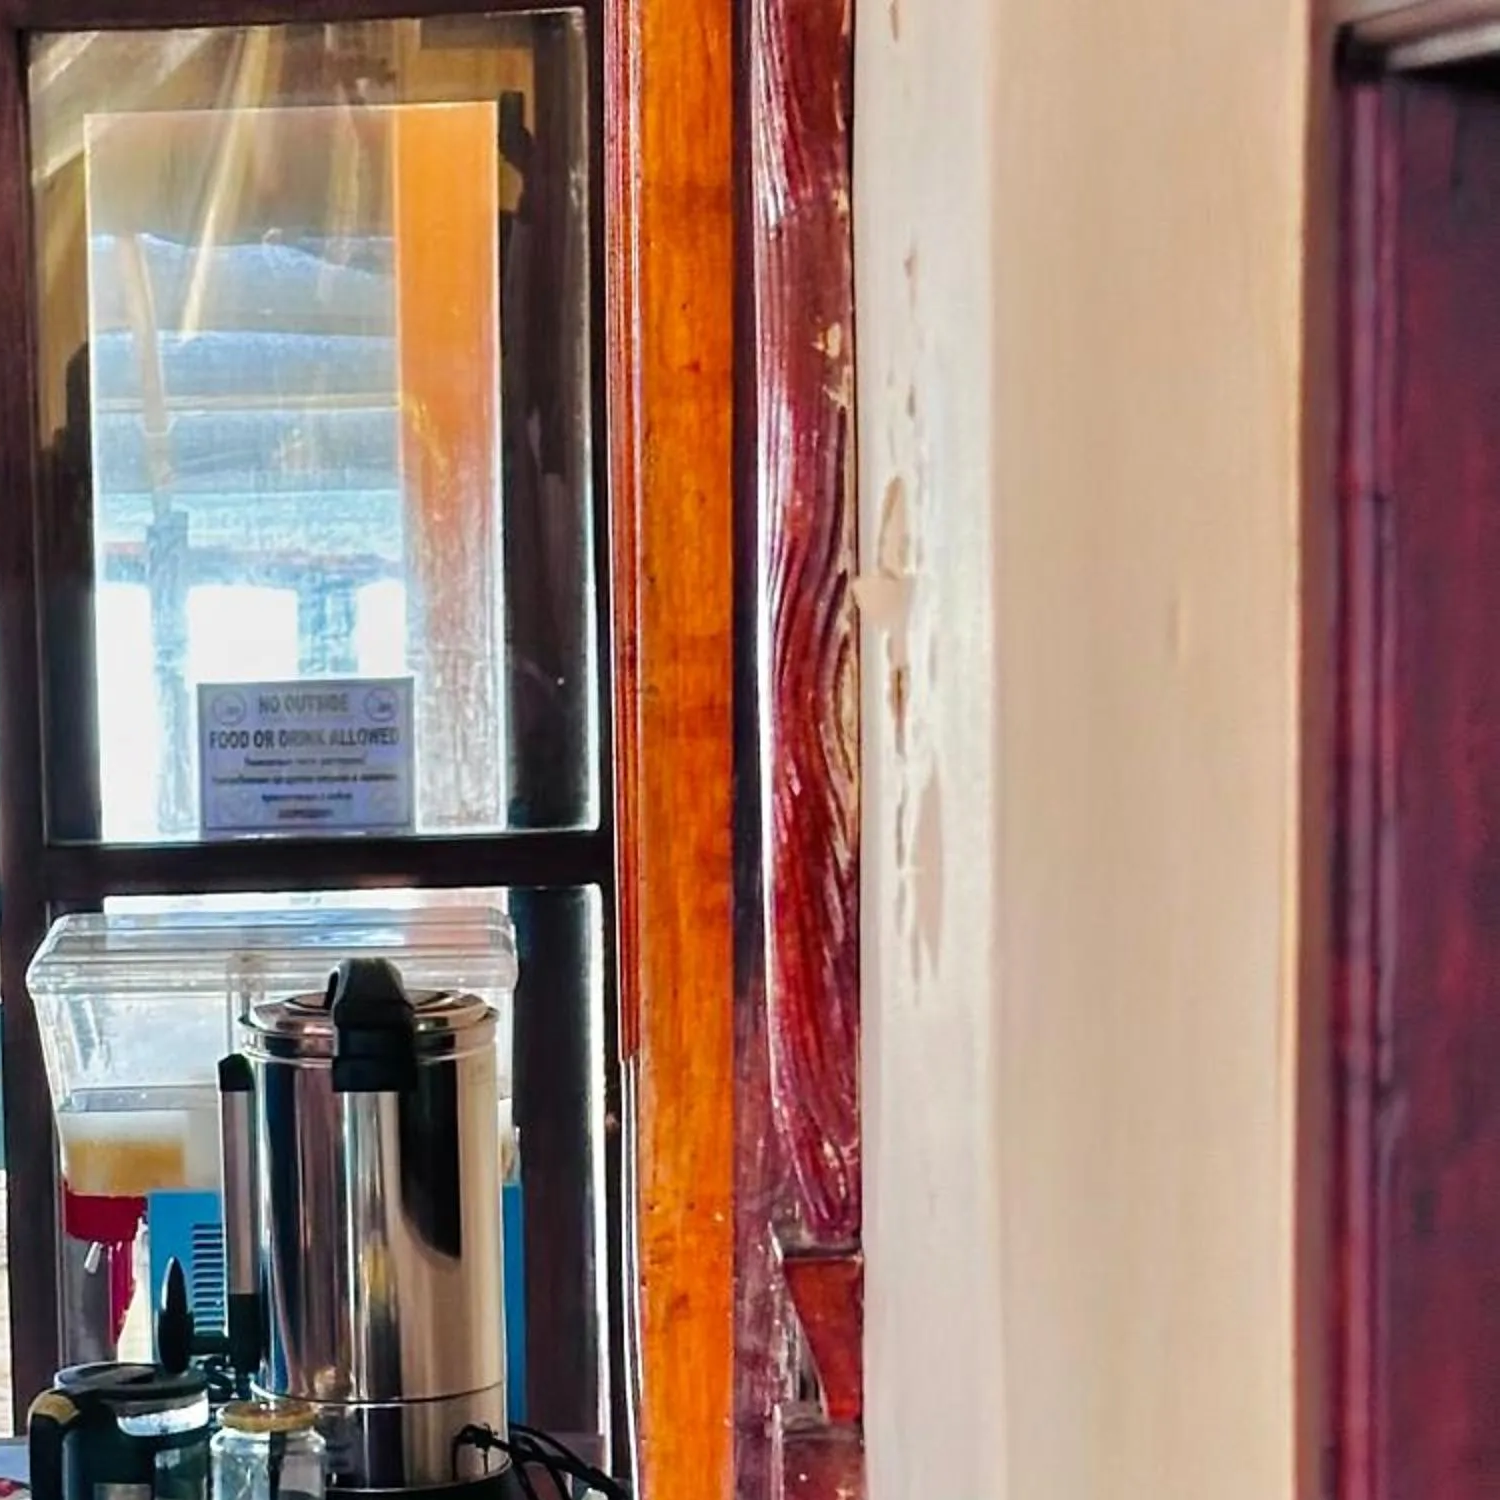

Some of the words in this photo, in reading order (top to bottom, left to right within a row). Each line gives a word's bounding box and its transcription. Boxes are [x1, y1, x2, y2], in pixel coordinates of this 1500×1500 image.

[258, 694, 280, 714] NO
[209, 730, 250, 749] FOOD
[253, 729, 275, 749] OR
[329, 726, 400, 746] ALLOWED
